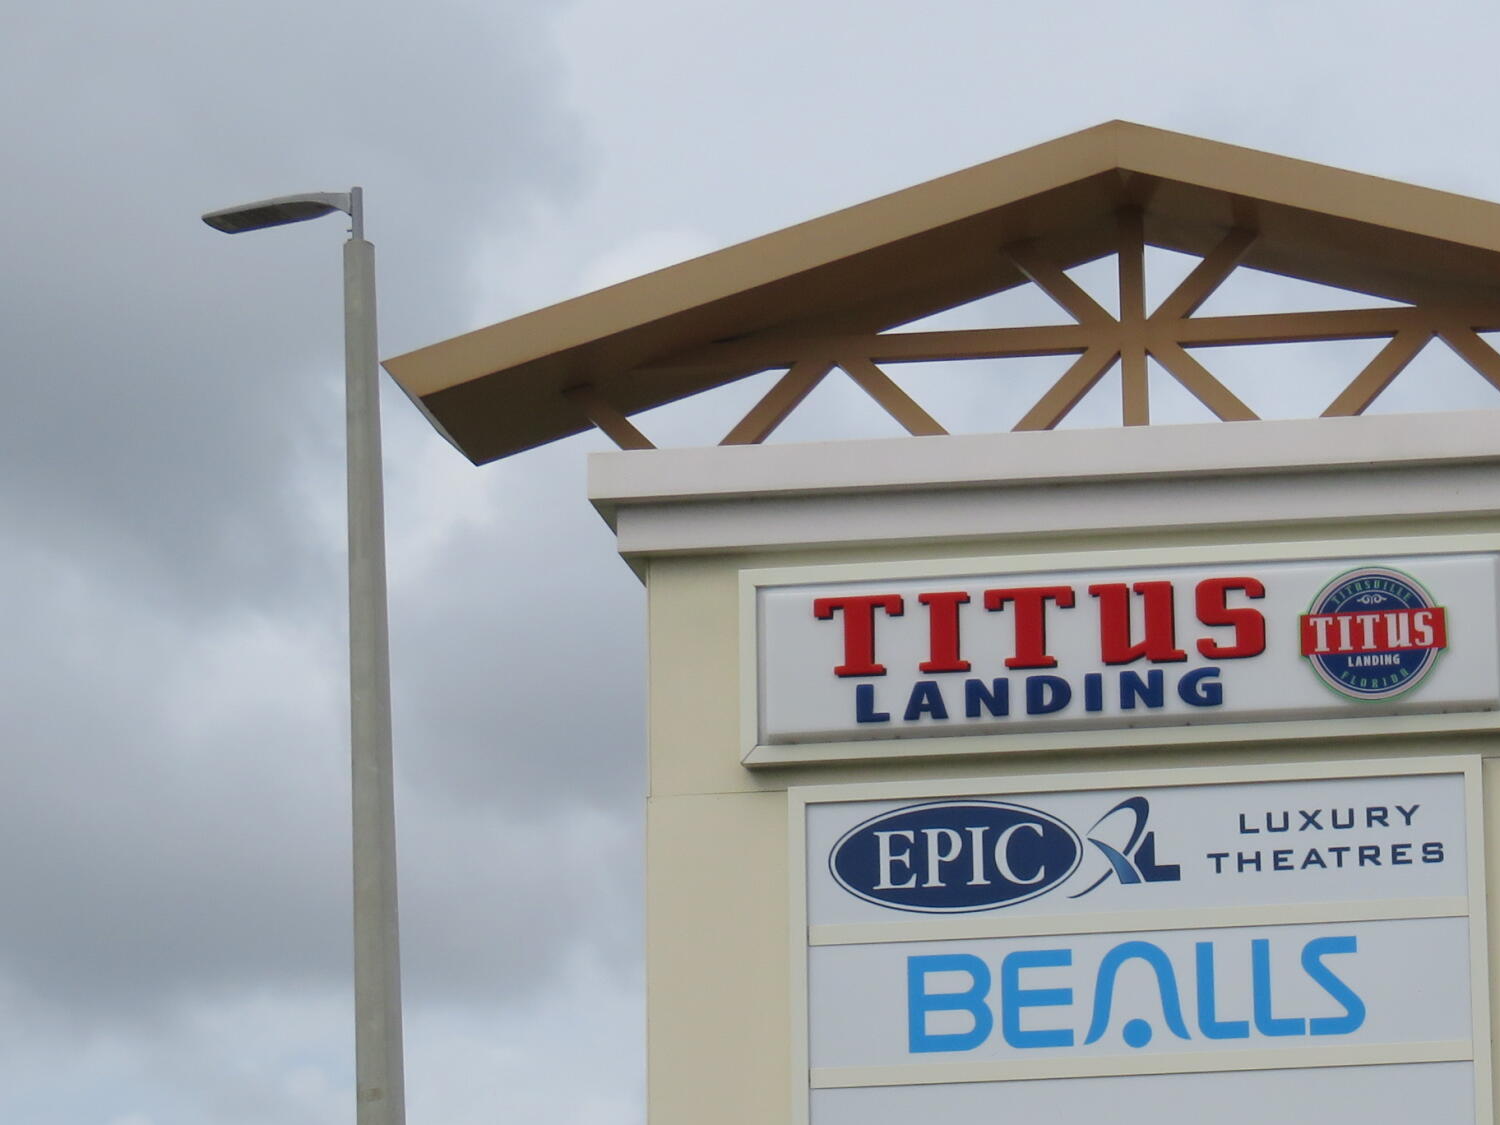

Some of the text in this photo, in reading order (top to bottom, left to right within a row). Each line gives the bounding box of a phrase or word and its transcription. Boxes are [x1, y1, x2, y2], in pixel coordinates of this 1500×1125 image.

[813, 576, 1266, 677] TITUS
[1309, 611, 1434, 652] TITUS
[1340, 668, 1409, 688] FLORIDA
[1348, 653, 1400, 668] LANDING
[855, 666, 1224, 723] LANDING
[1238, 804, 1421, 835] LUXURY
[872, 821, 1047, 891] EPIC
[1206, 841, 1446, 874] THEATRES
[906, 935, 1367, 1054] BEALLS
